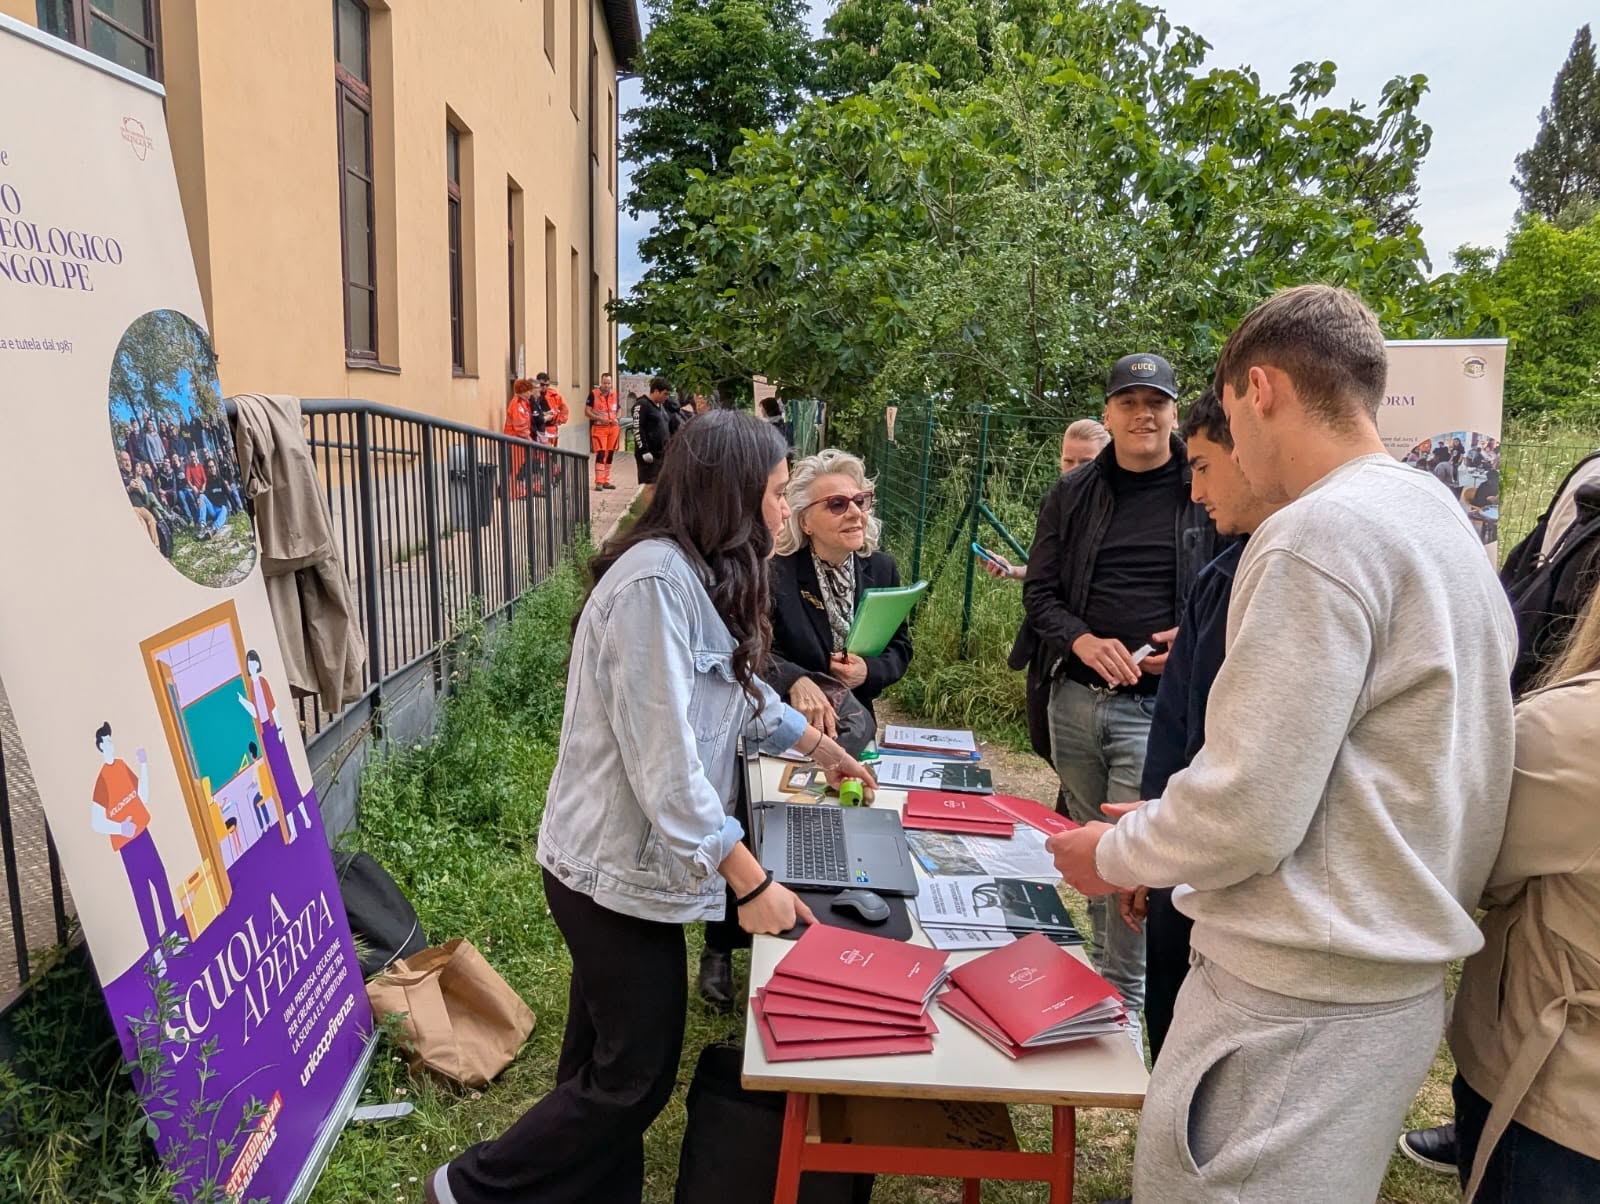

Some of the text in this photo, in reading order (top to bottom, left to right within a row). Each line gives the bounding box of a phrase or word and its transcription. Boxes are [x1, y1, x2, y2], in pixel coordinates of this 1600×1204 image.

[8, 339, 16, 350] e
[15, 337, 41, 351] tutela
[42, 338, 56, 351] dal
[56, 339, 73, 354] 1987
[1131, 362, 1156, 372] GUCCI
[165, 892, 290, 1065] SCUOLA
[243, 890, 335, 1046] APERTA
[283, 936, 341, 1023] UNA PREZIOSA OCCASIONE
[287, 951, 344, 1039] PER CREARE UN PONTE TRA
[292, 966, 347, 1055] LA SCUOLA E IL TERRITORIO
[300, 993, 355, 1087] unicoopfirenze
